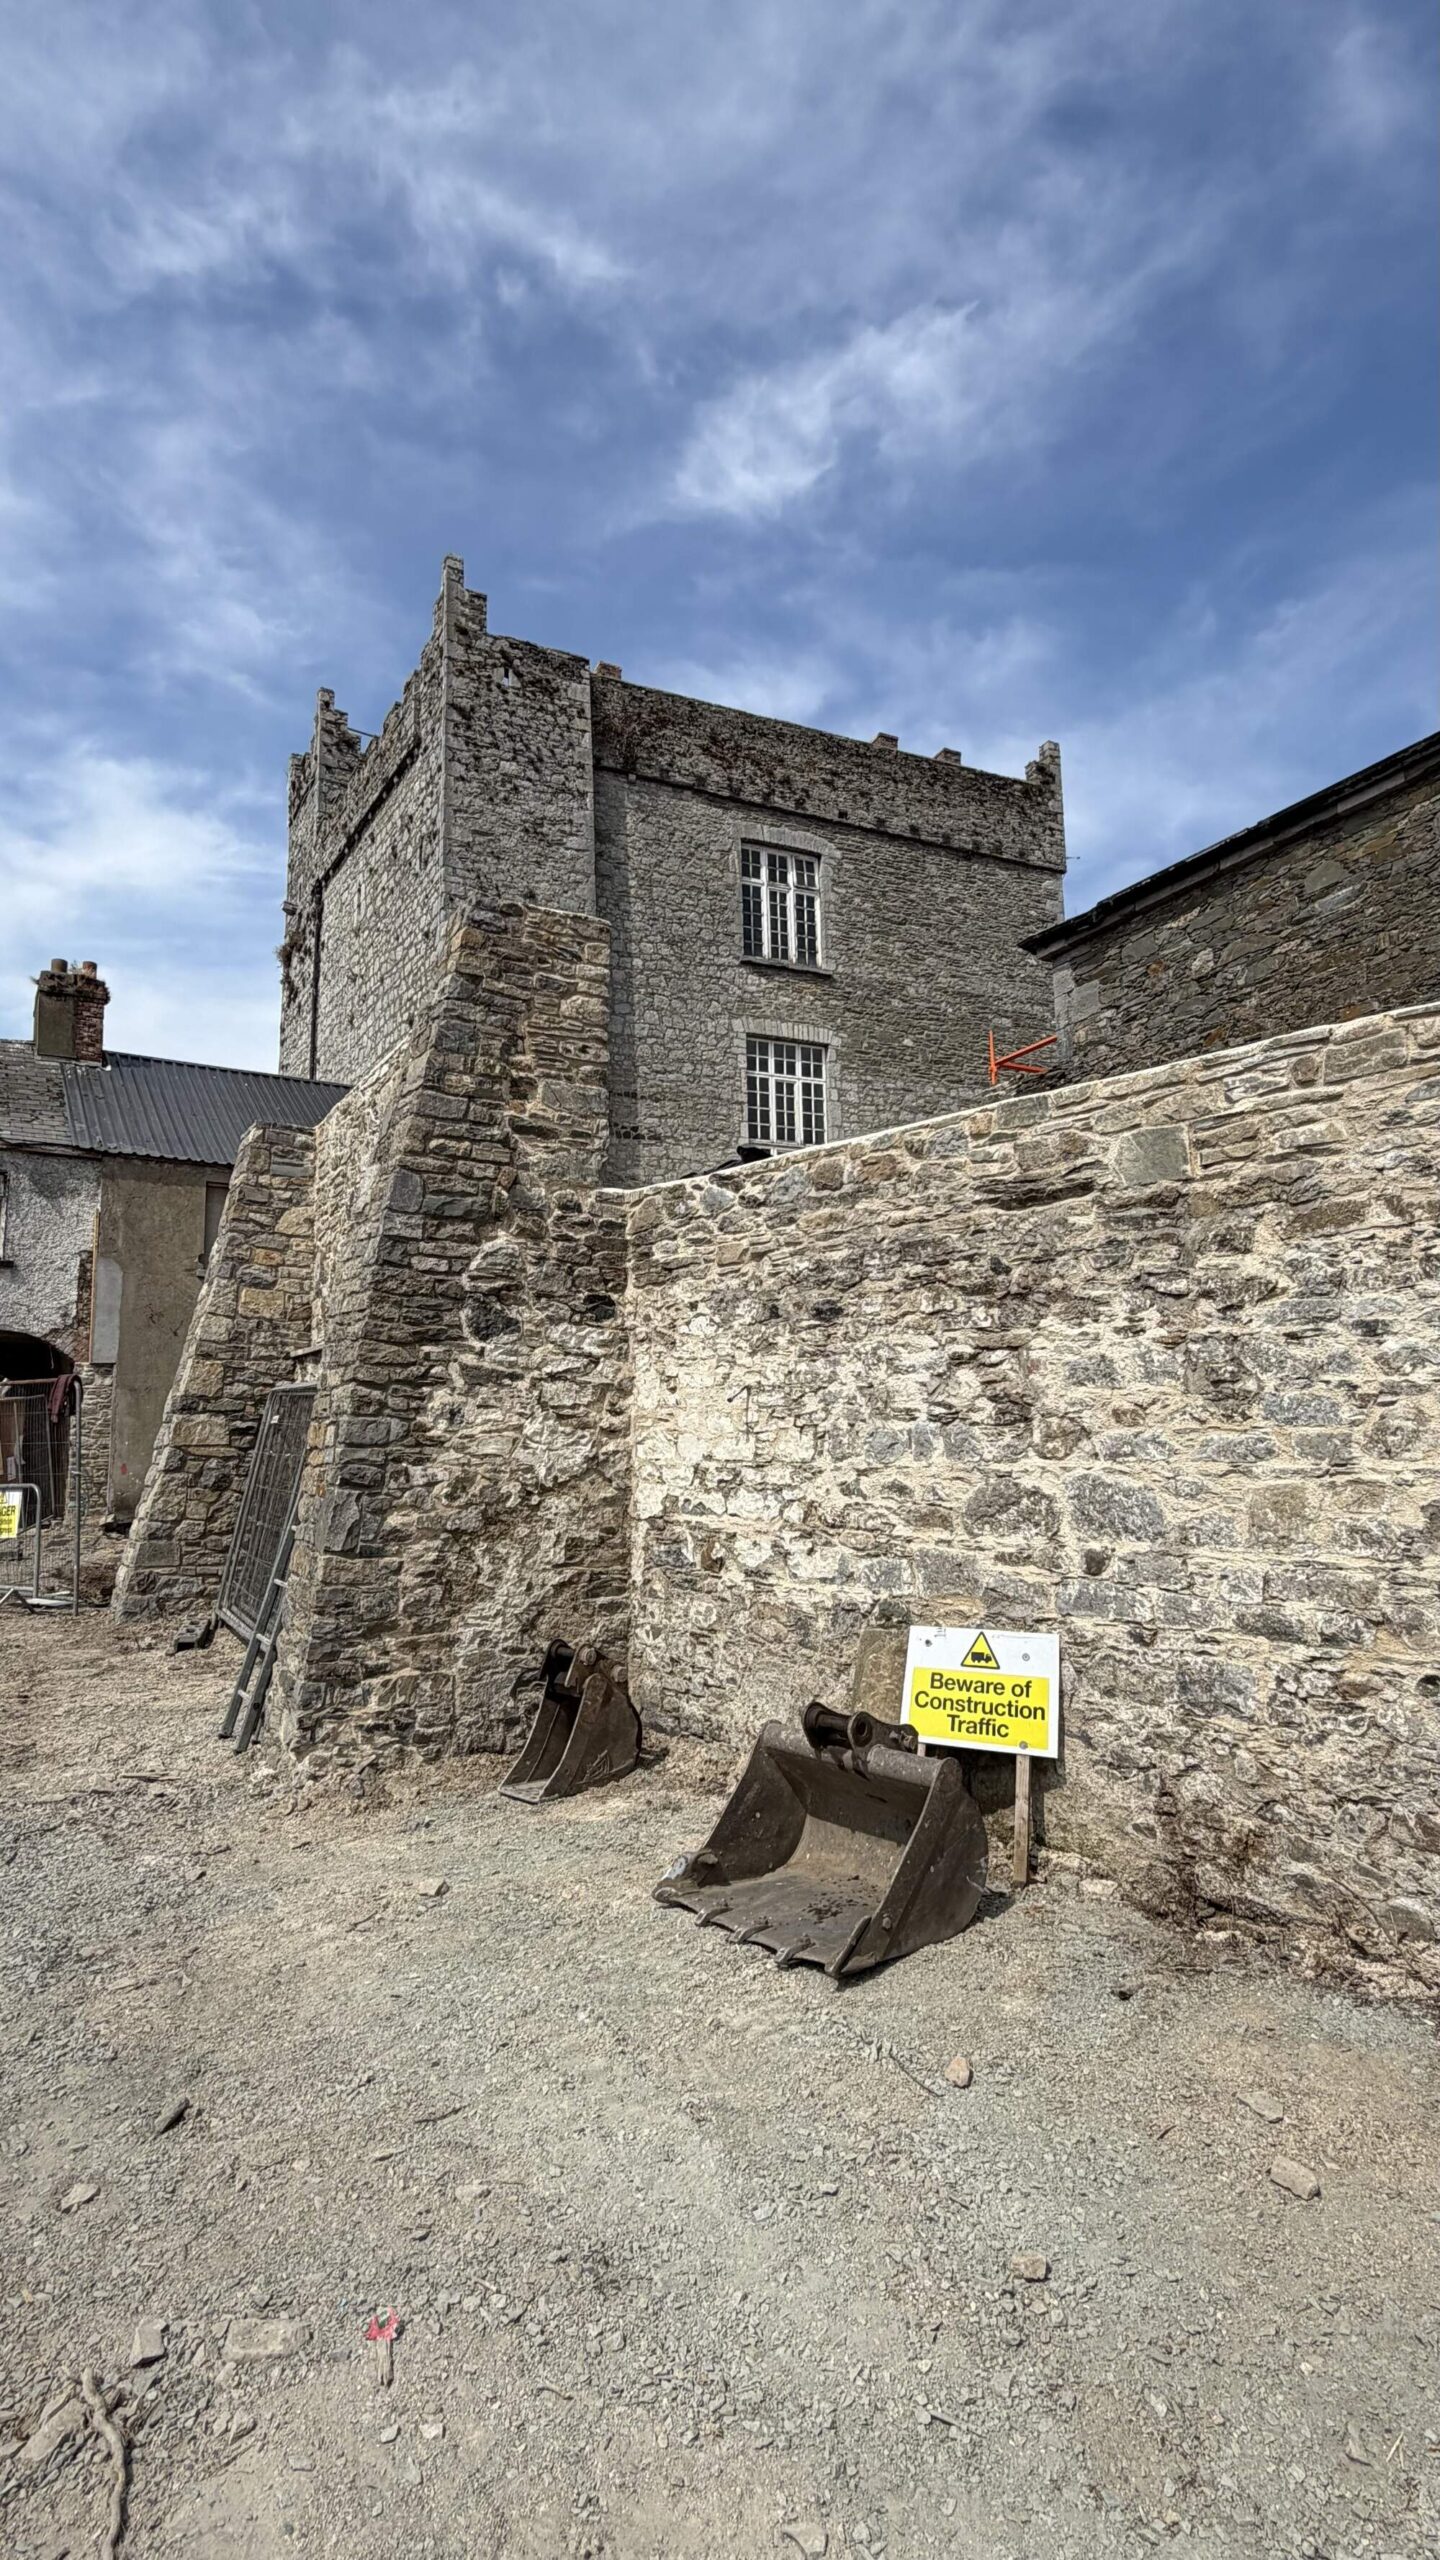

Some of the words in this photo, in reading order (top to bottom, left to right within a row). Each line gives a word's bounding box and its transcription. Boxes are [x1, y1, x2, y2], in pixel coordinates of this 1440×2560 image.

[930, 1672, 1005, 1695] Beware
[1011, 1680, 1032, 1698] of
[914, 1691, 1046, 1720] Construction
[947, 1714, 1009, 1738] Traffic
